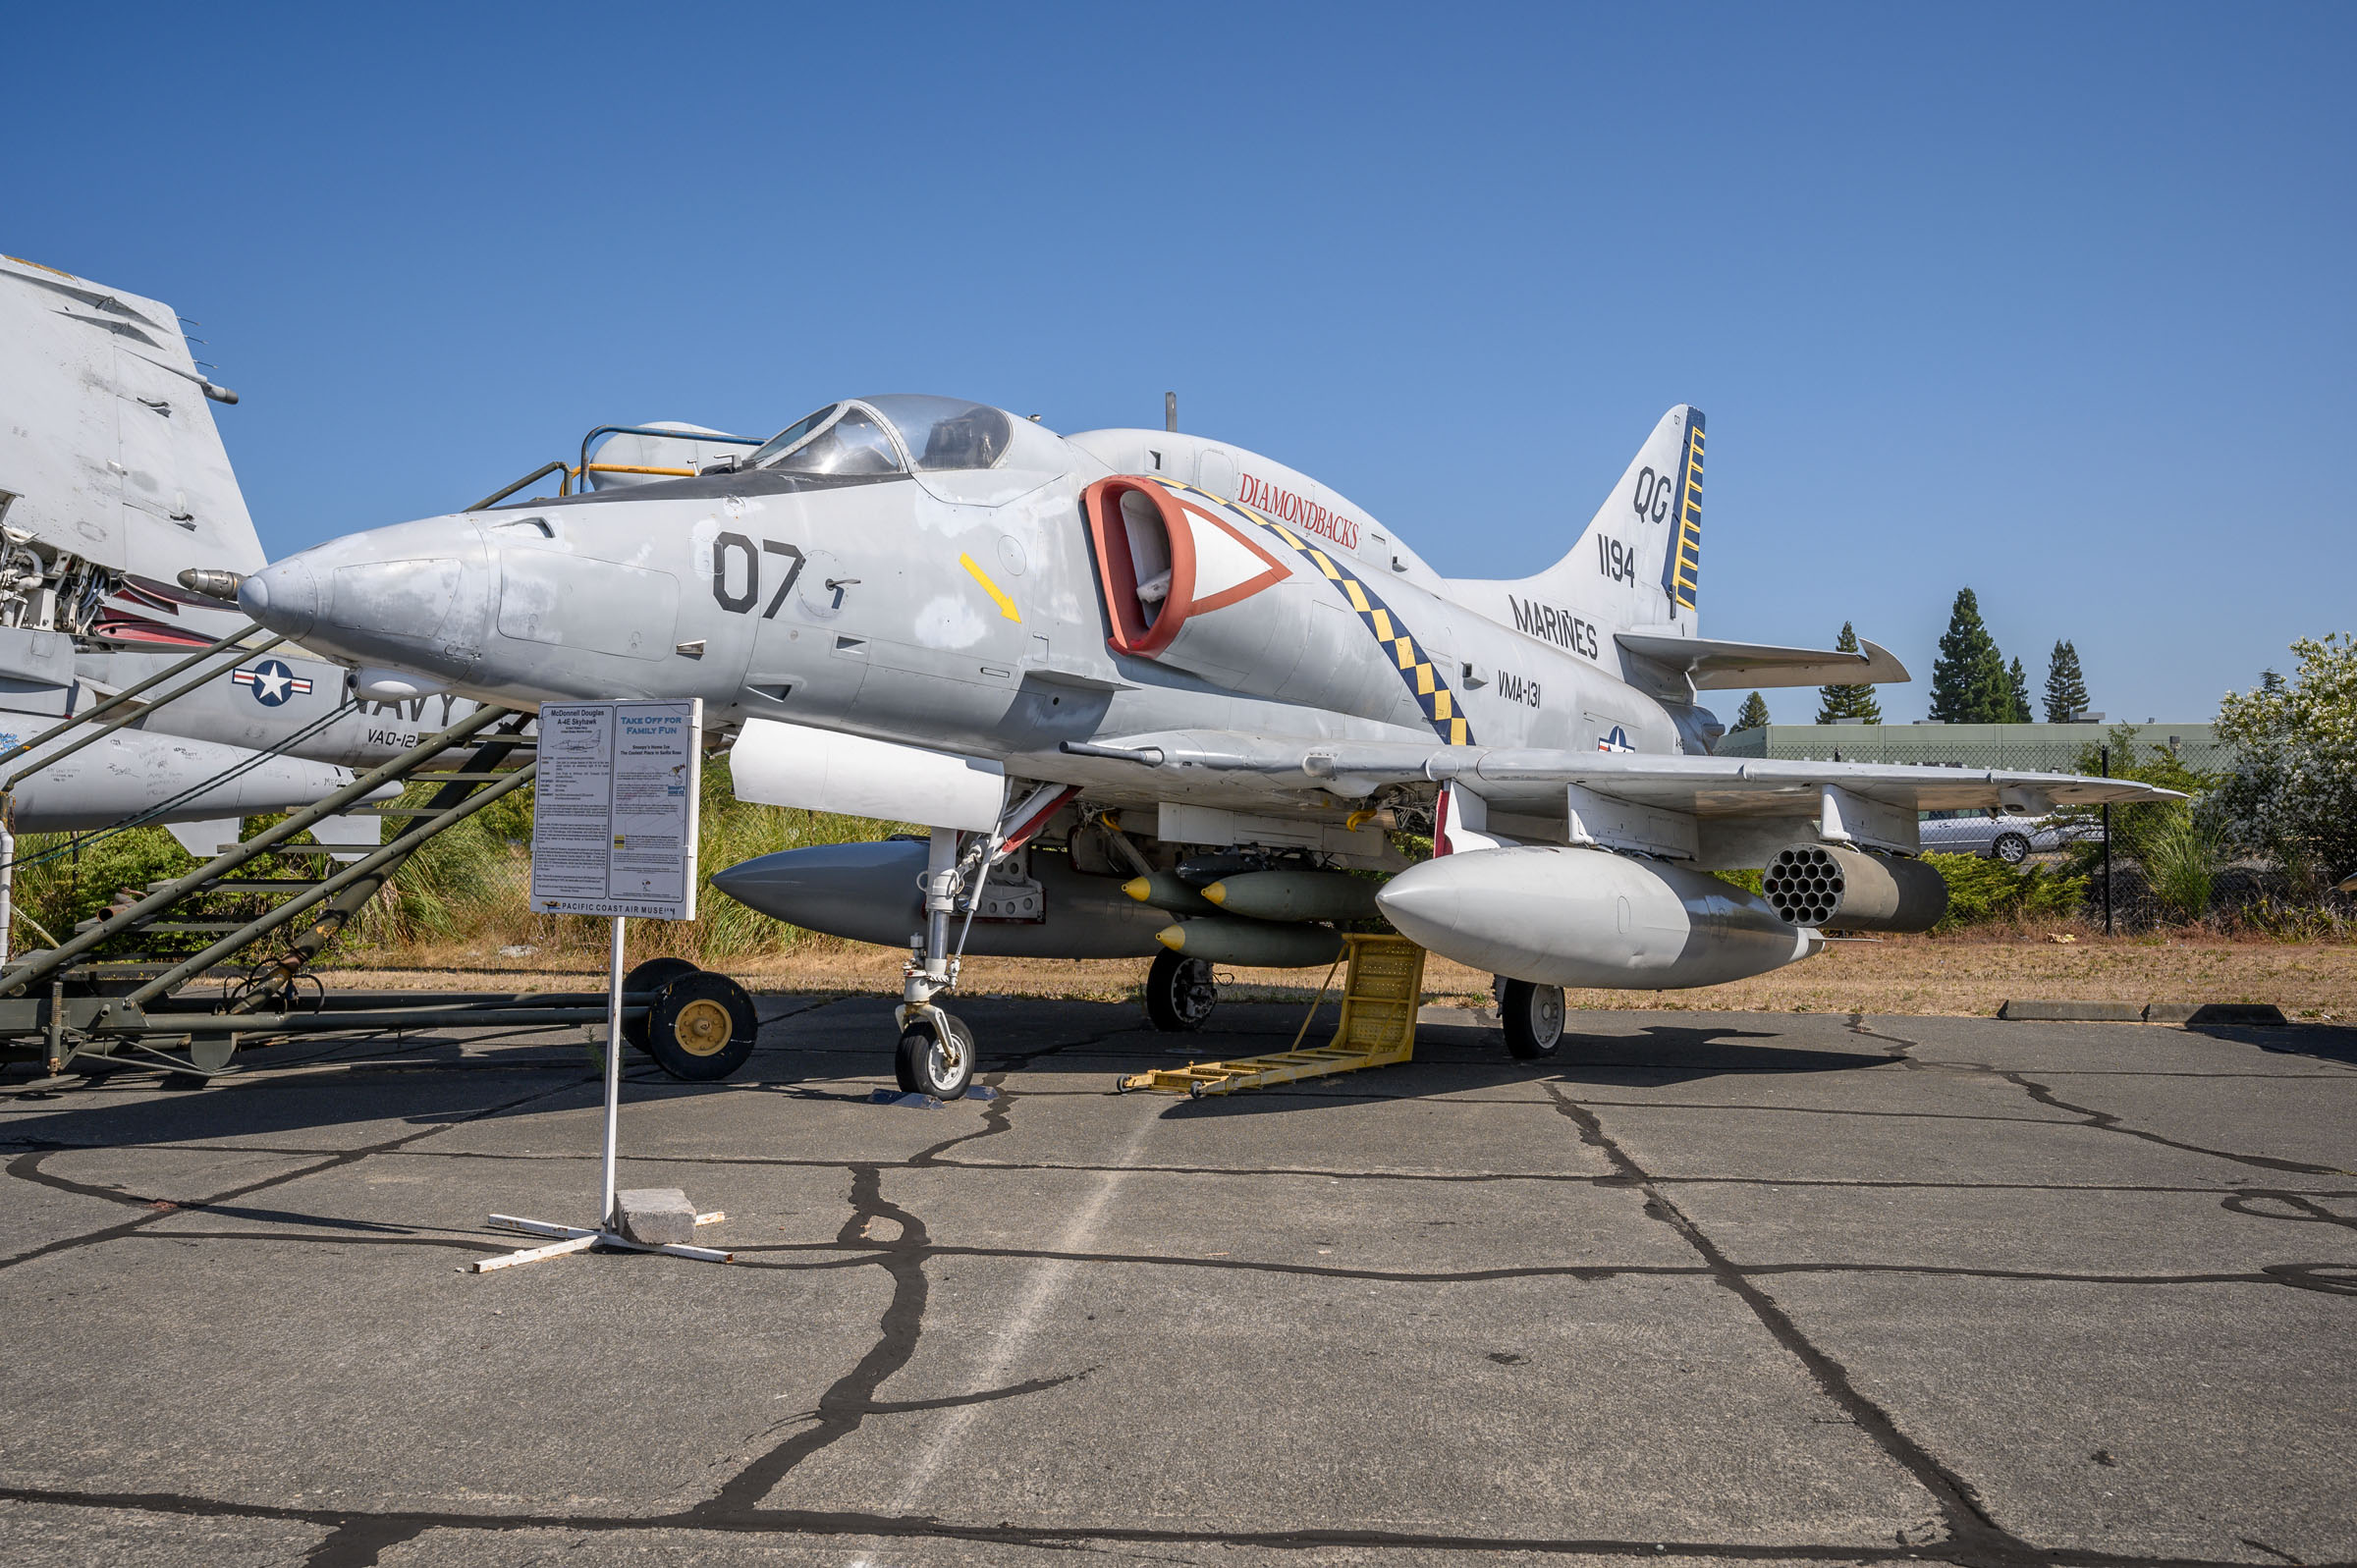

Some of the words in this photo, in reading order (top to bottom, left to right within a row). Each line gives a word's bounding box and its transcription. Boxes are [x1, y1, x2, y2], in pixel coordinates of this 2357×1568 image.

[1237, 472, 1359, 550] DIAMONDBACKS
[1633, 465, 1672, 524] QG
[713, 531, 806, 620] 07
[1598, 533, 1635, 589] 1194
[1508, 594, 1598, 661] MARINES
[1498, 670, 1541, 709] VMA-131
[572, 718, 597, 727] Skyhawk
[580, 709, 605, 718] Douglas
[644, 716, 663, 725] OFF
[368, 729, 418, 748] VAQ-12
[562, 902, 594, 911] PACIFIC
